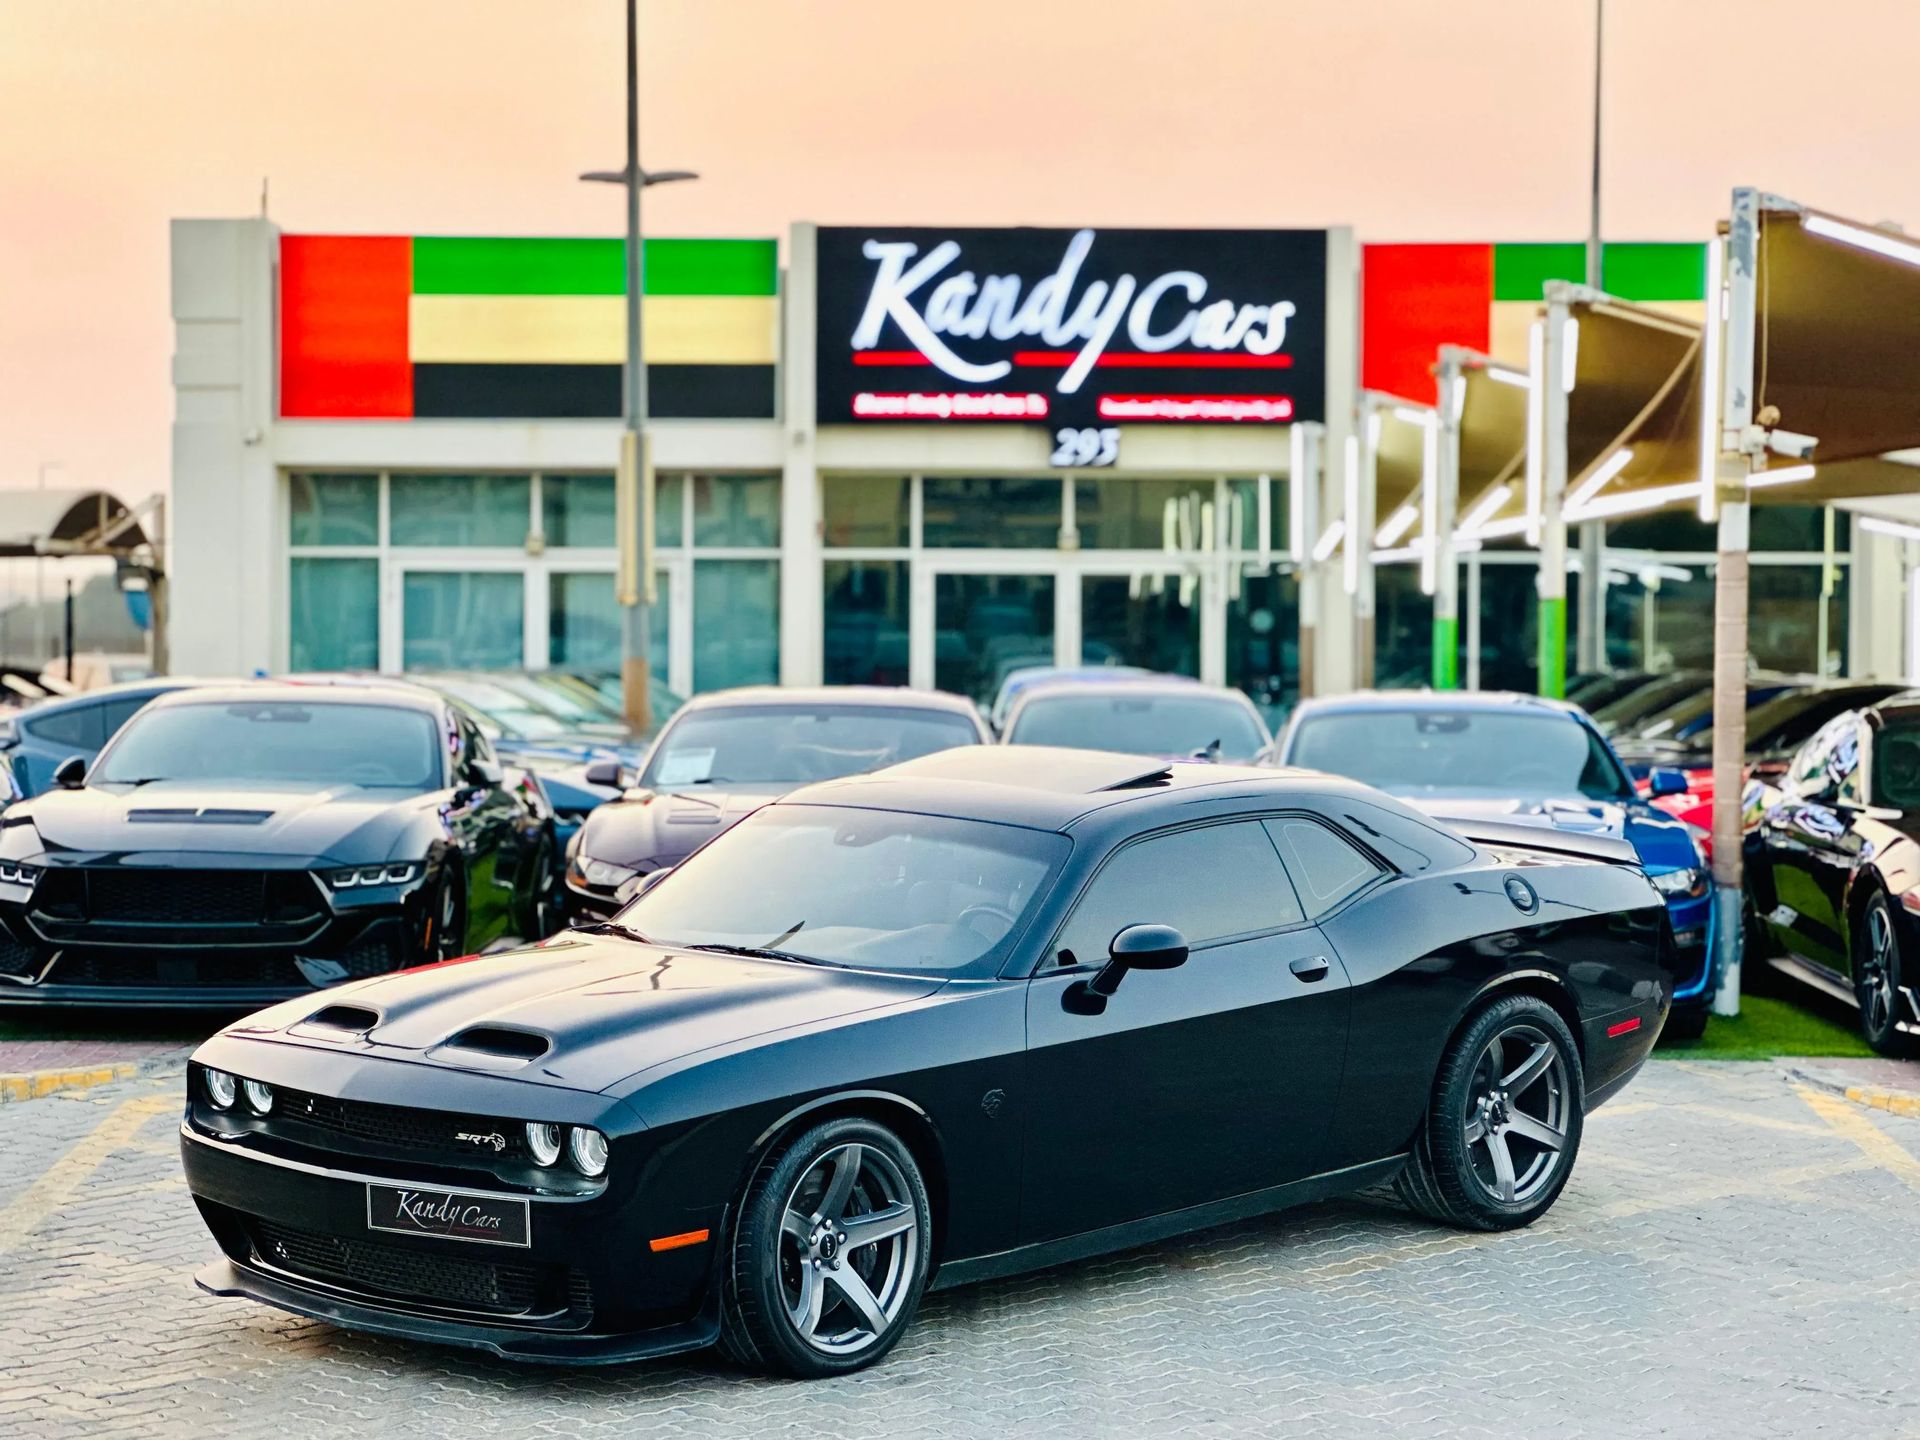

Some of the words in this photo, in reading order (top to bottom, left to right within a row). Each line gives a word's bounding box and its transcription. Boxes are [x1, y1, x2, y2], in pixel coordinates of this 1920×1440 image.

[851, 228, 1137, 394] Kandy
[1128, 270, 1296, 355] Cars
[1050, 427, 1121, 467] 295
[454, 1132, 495, 1145] SRT
[396, 1190, 461, 1235] Kandy
[461, 1205, 501, 1229] Cars
